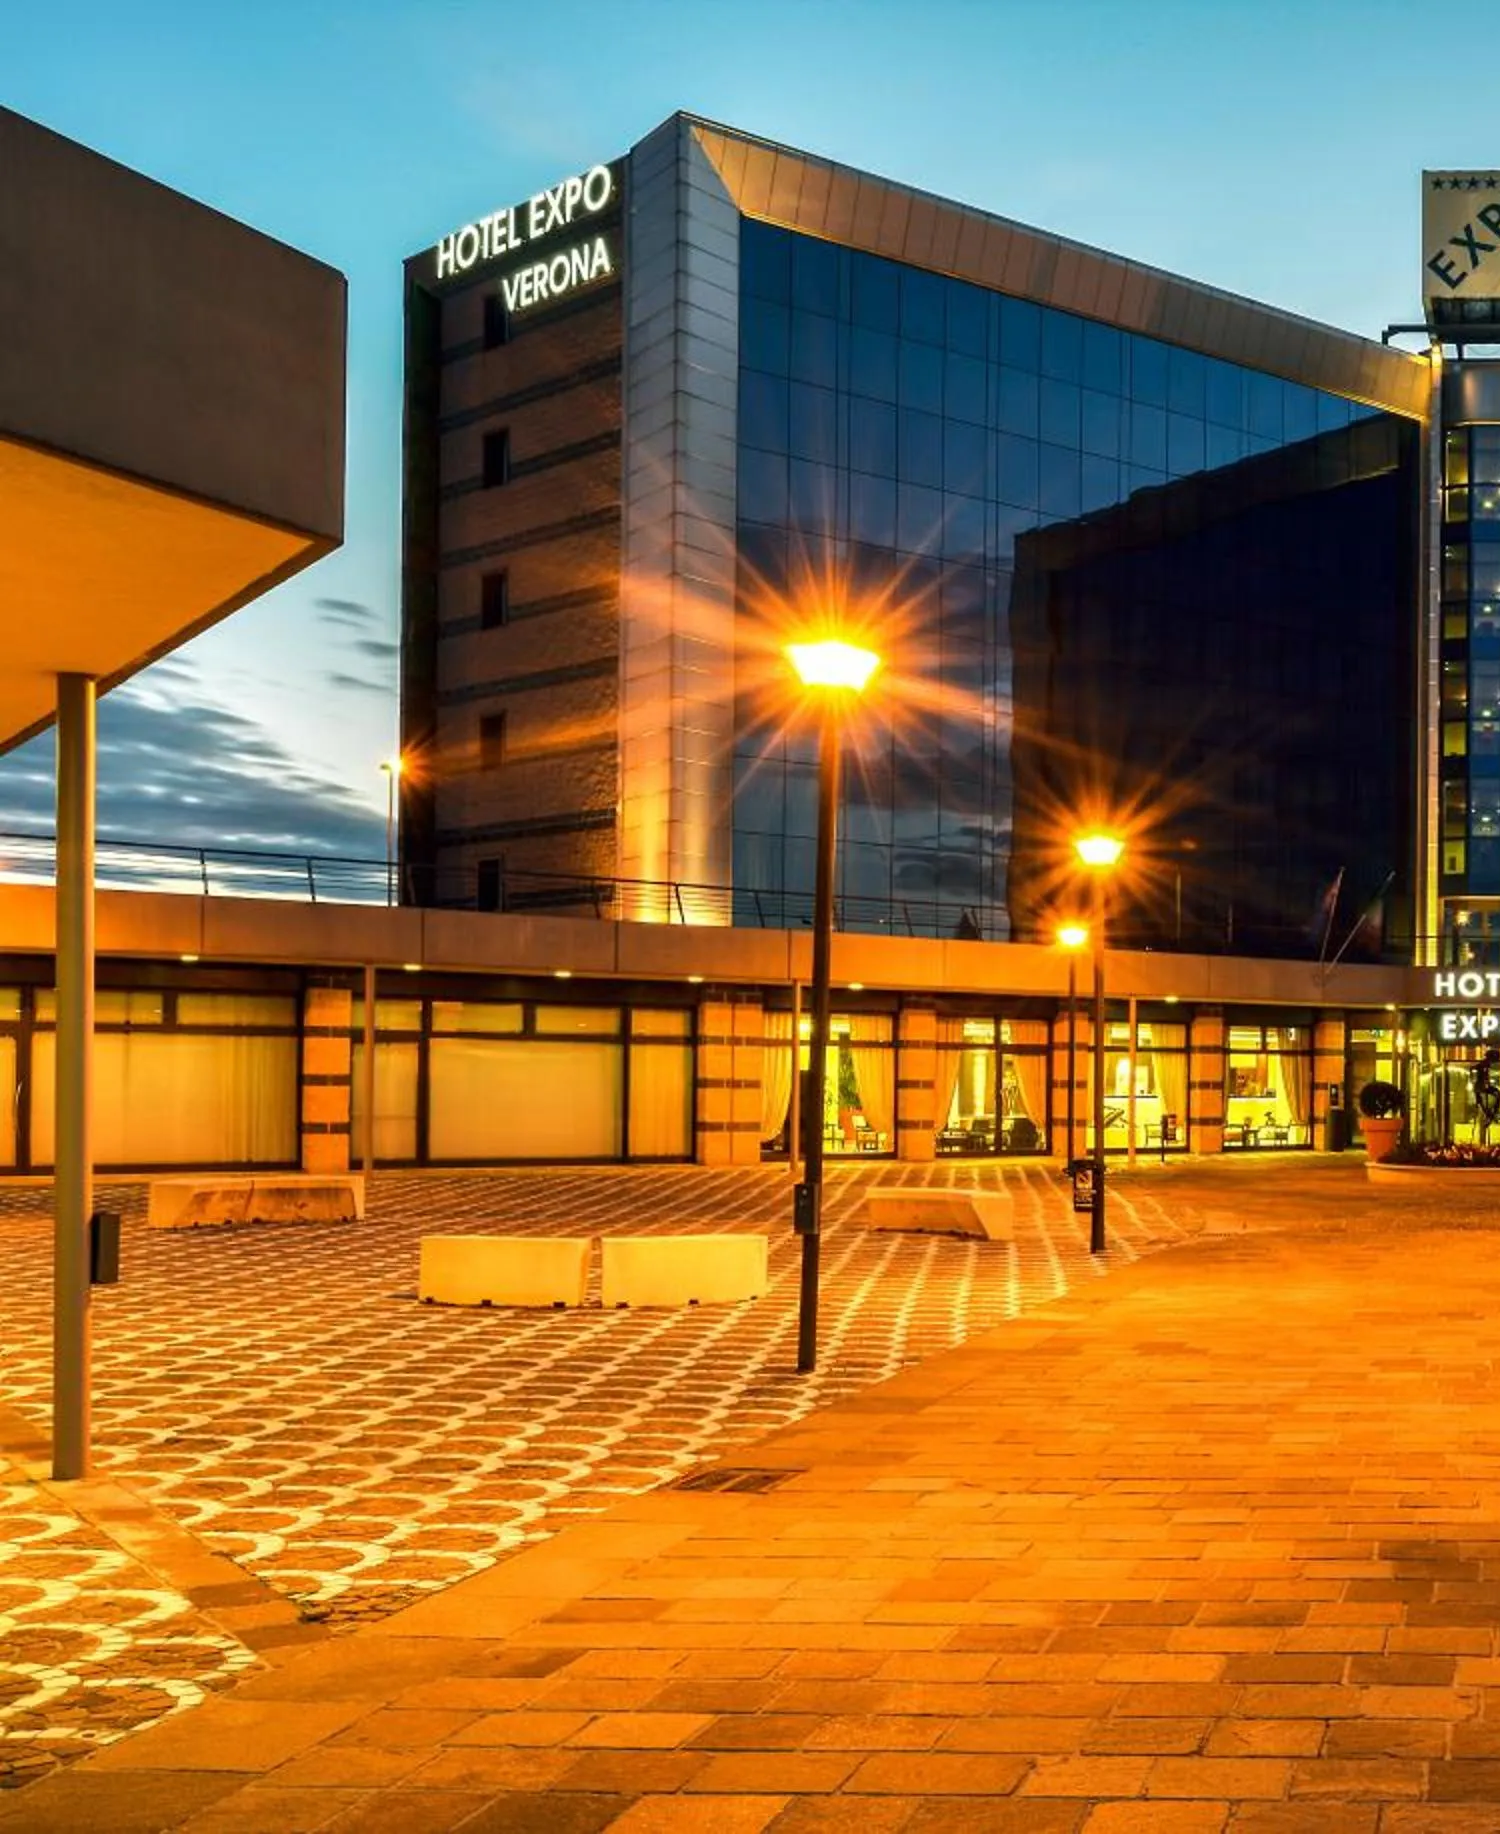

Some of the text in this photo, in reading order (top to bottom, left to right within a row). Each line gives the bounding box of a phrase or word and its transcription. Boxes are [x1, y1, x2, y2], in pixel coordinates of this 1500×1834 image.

[437, 165, 611, 279] HOTEL EXPO
[503, 238, 611, 312] VERONA
